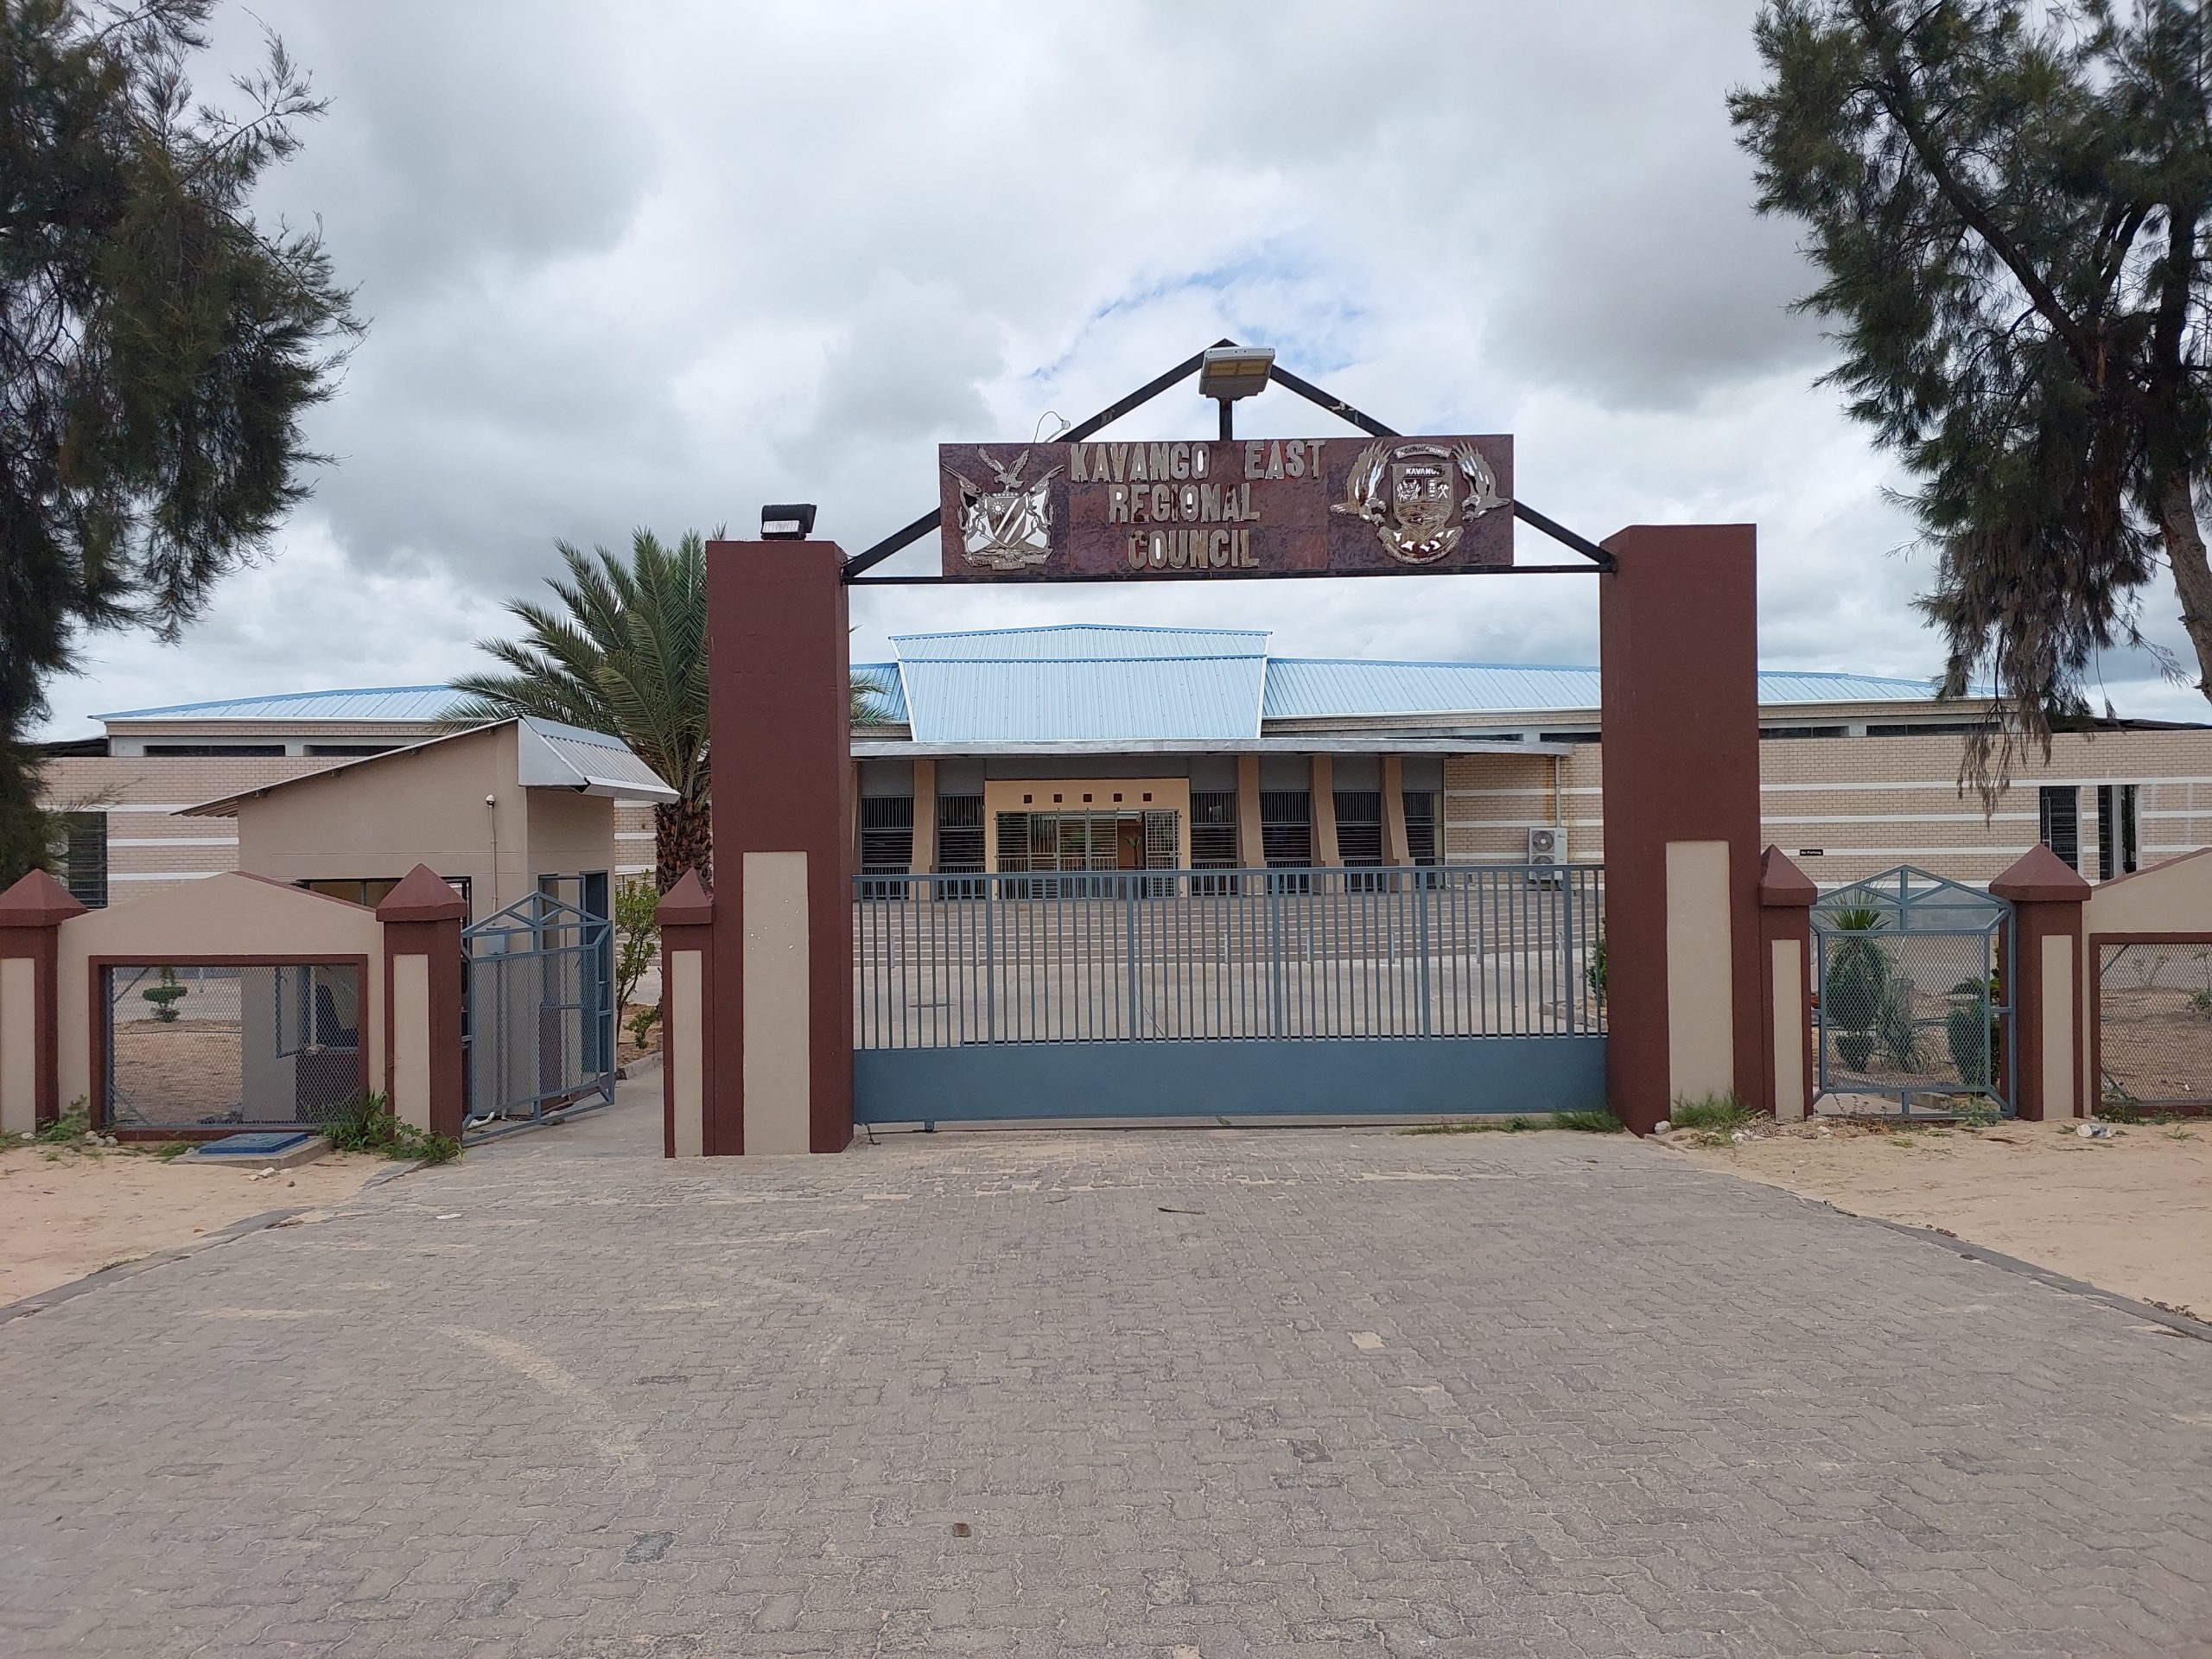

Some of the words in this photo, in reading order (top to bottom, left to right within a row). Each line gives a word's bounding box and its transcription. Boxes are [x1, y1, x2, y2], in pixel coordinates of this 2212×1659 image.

[1071, 442, 1210, 482] KAVANGO
[1244, 439, 1325, 480] EAST
[1109, 483, 1261, 524] REGIONAL
[1128, 529, 1260, 569] COUNCIL
